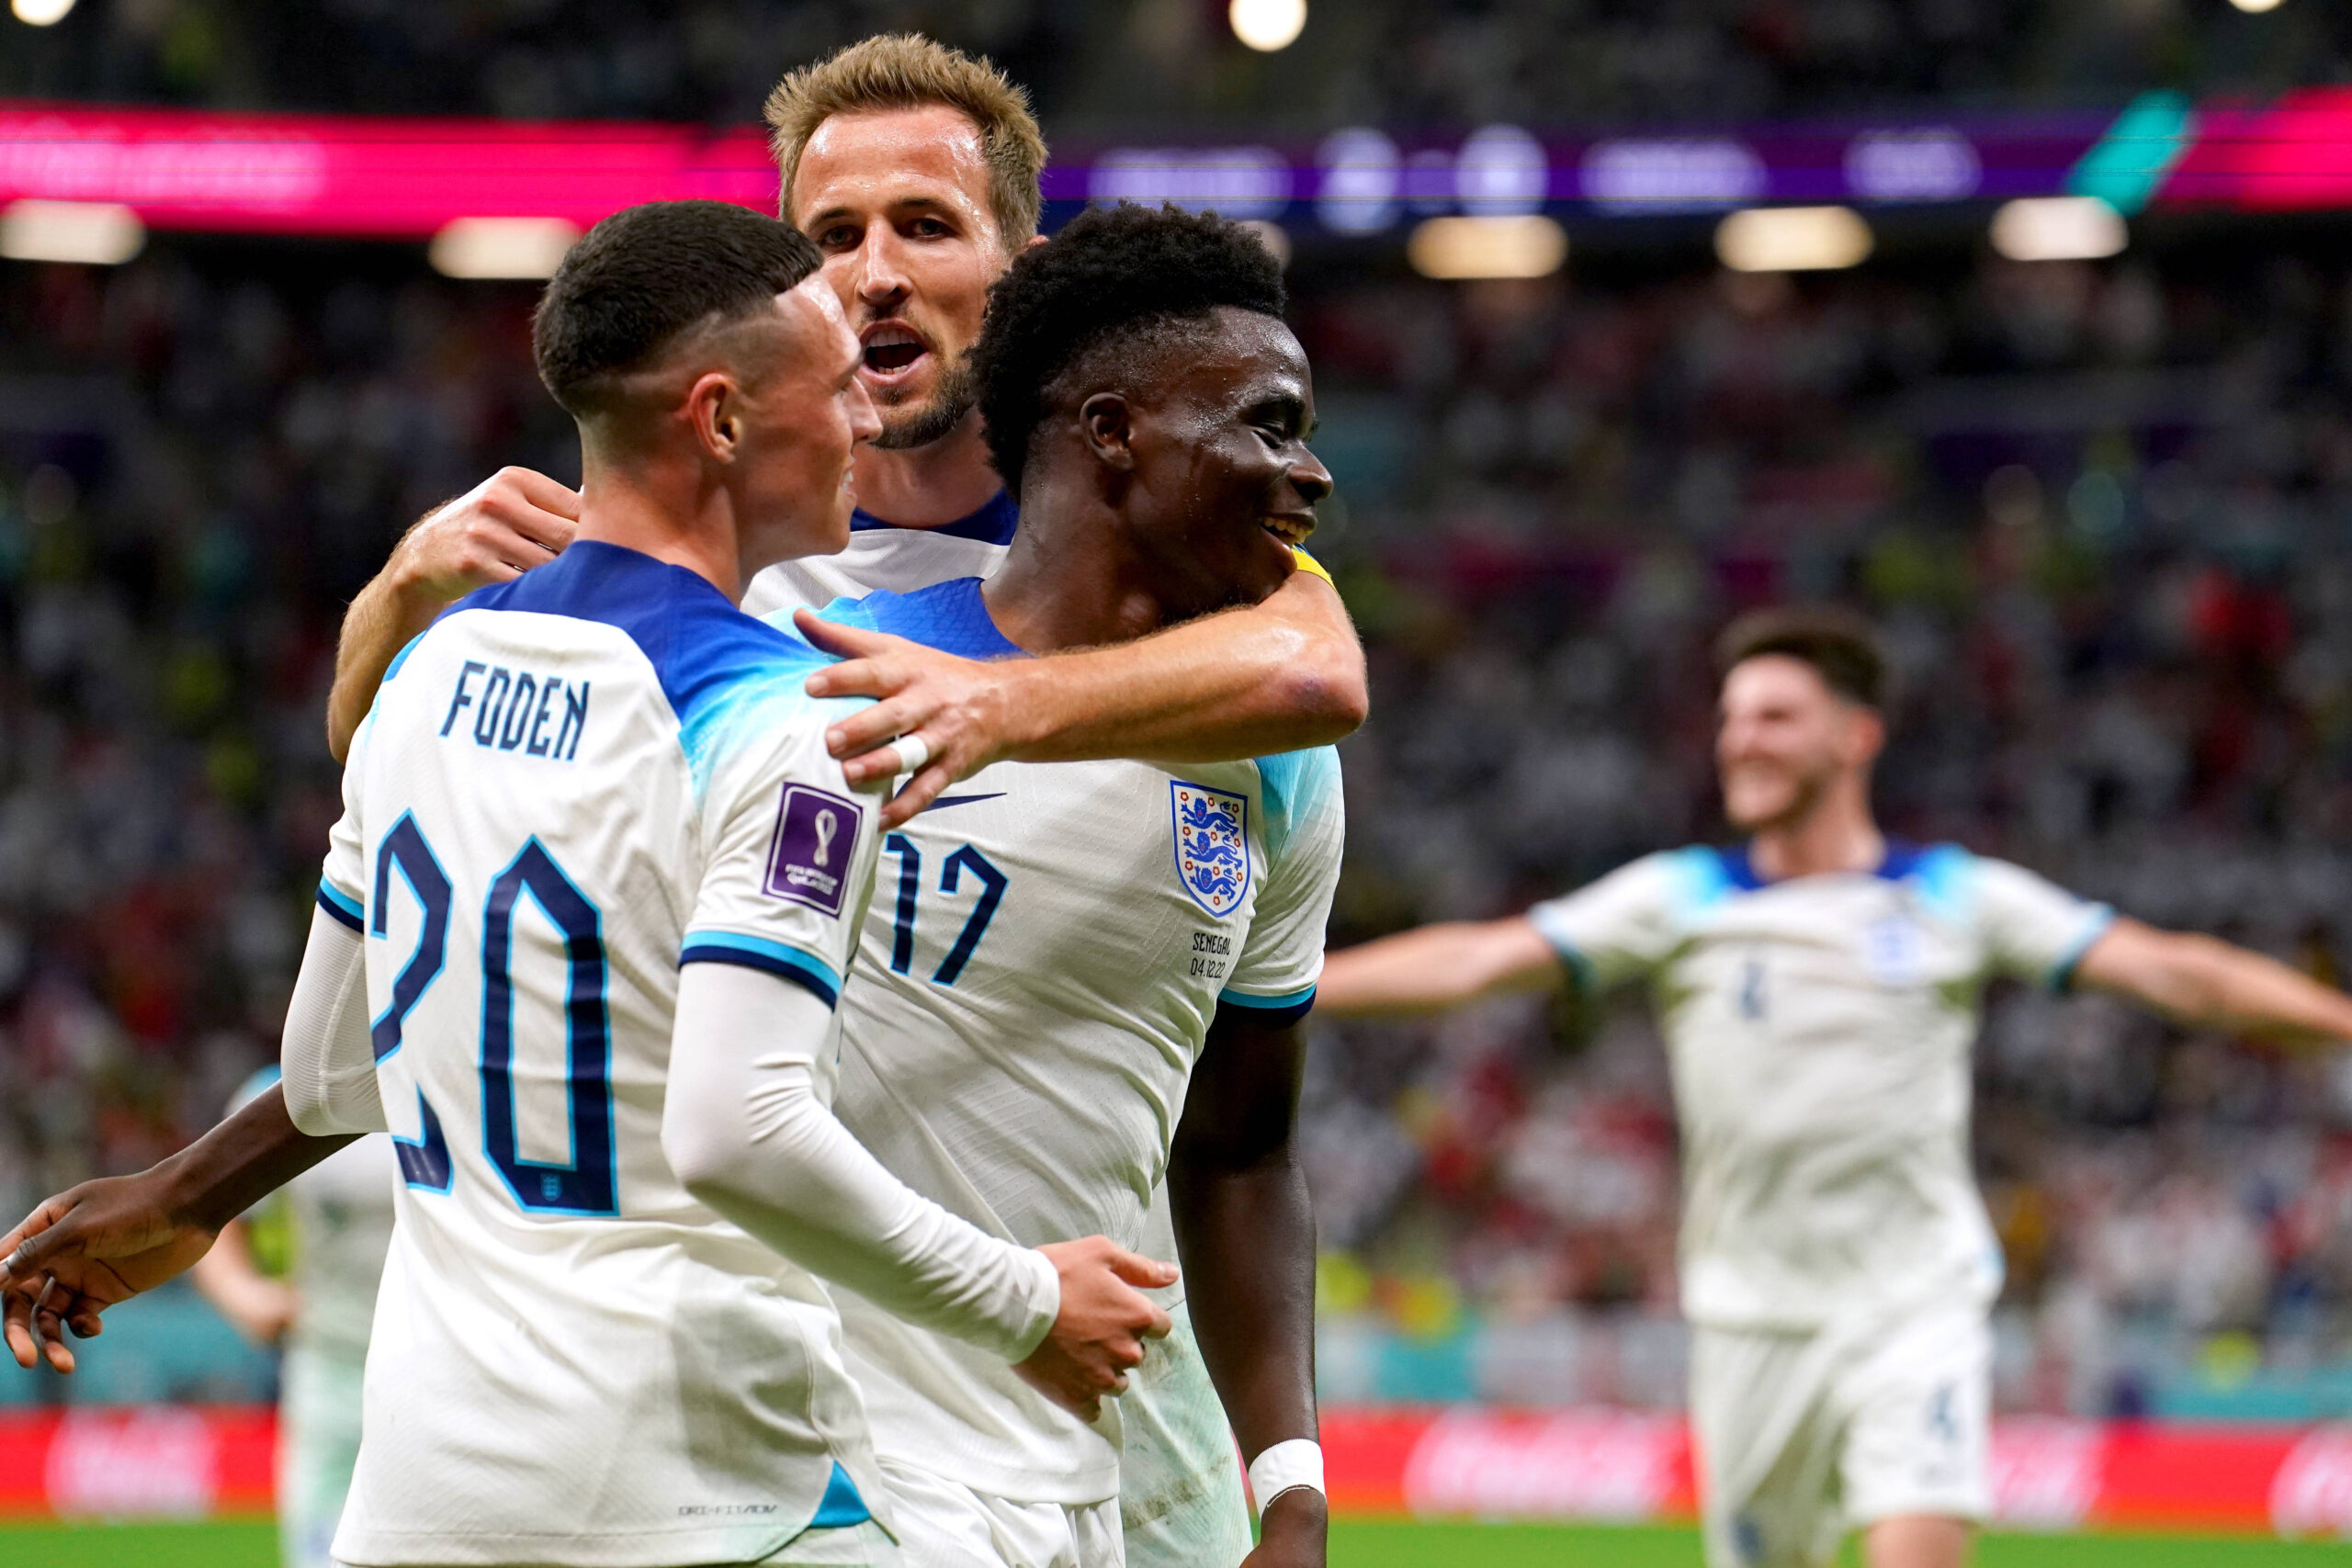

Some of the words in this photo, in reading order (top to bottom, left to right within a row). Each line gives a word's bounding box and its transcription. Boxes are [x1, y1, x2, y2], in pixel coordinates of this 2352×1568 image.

[438, 660, 591, 761] FODEN
[885, 832, 1010, 987] 17
[1192, 932, 1231, 956] SENEGAL
[369, 807, 620, 1216] 20
[1190, 957, 1226, 979] 04.12.22
